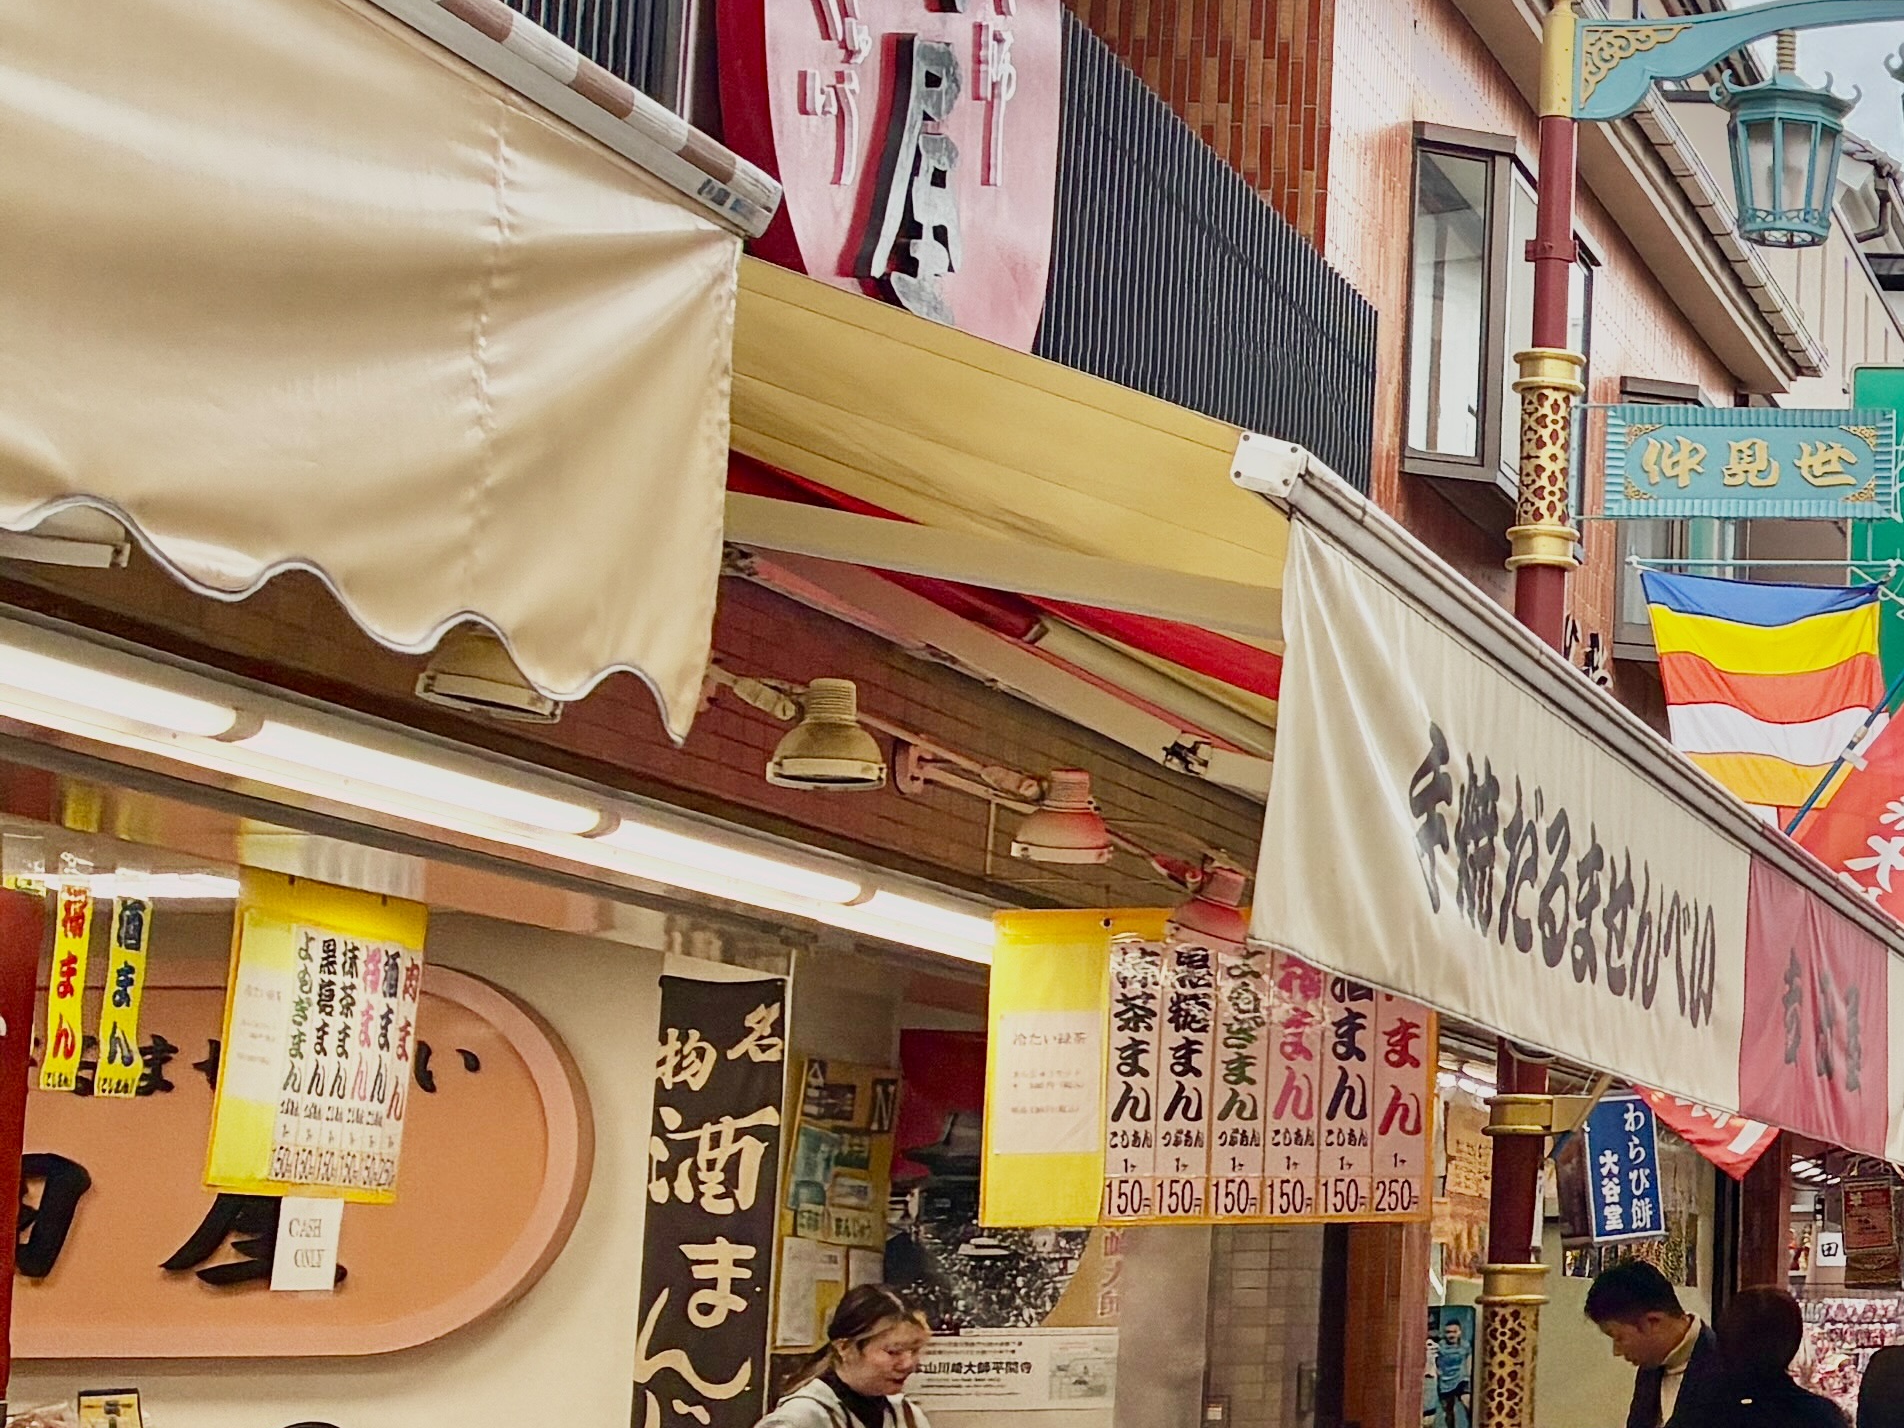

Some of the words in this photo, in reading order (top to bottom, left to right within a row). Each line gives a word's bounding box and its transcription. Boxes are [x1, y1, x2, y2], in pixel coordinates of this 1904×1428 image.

[1641, 435, 1858, 491] 仲見世
[1377, 988, 1423, 1137] まん
[1598, 1148, 1624, 1232] 大谷堂
[1623, 1101, 1653, 1230] わらび餅
